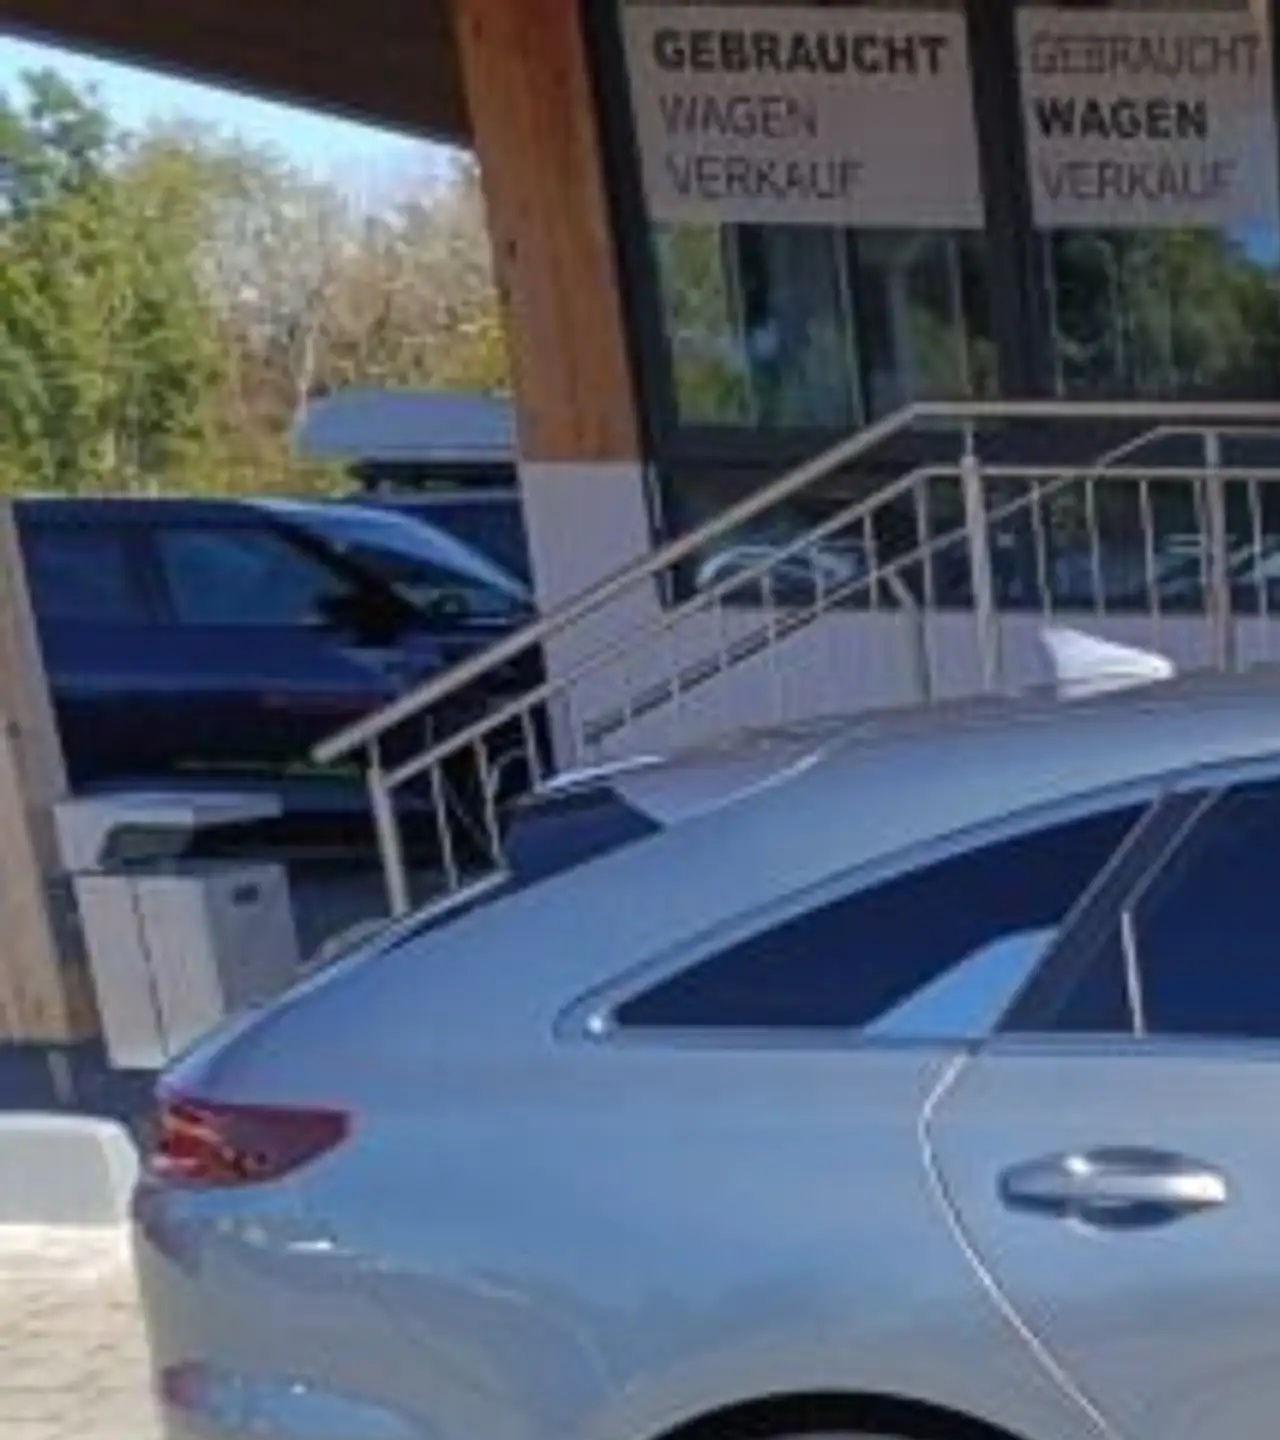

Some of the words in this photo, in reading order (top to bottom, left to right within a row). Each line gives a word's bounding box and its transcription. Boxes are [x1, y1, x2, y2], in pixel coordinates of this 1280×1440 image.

[652, 29, 948, 74] GEBRAUCHT
[1031, 34, 1262, 76] GEBRAUCHT
[659, 95, 819, 139] WAGEN
[1034, 97, 1208, 140] WAGEN
[667, 155, 864, 200] VERKAUF
[1040, 159, 1238, 199] VERKAUF
